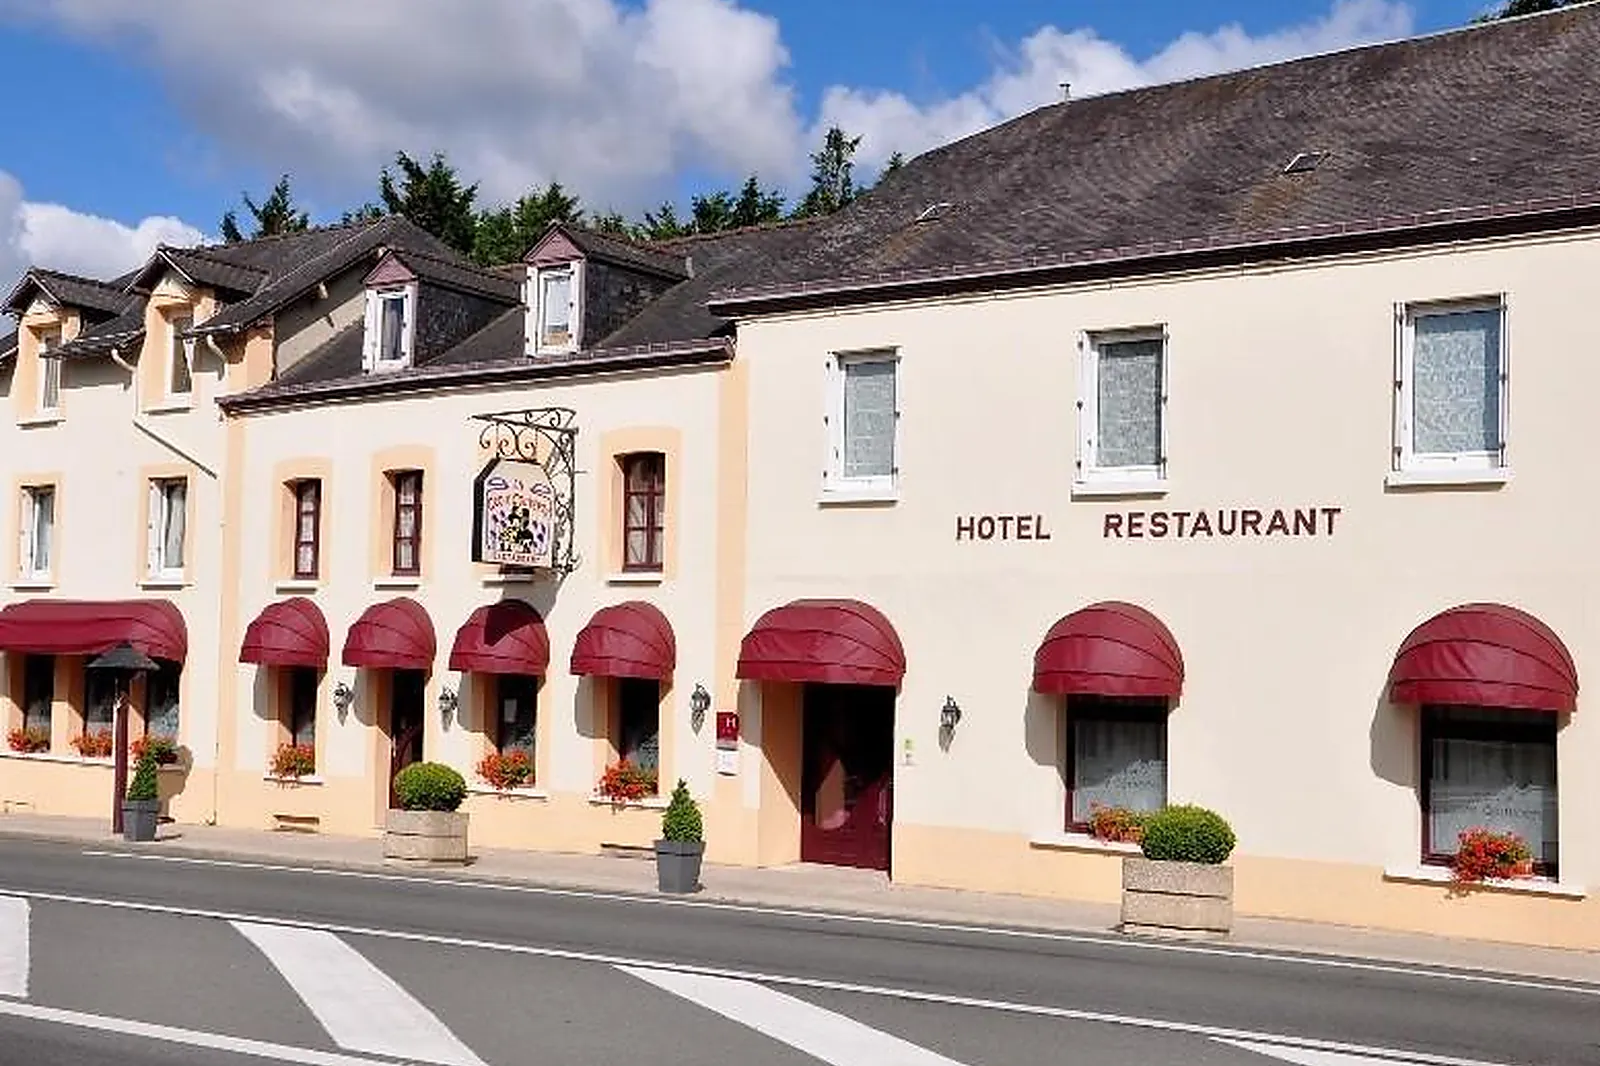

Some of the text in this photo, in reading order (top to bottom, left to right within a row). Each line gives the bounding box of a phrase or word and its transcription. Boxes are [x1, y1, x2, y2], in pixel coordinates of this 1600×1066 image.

[956, 507, 1342, 541] HOTEL RESTAURANT
[726, 717, 736, 728] H
